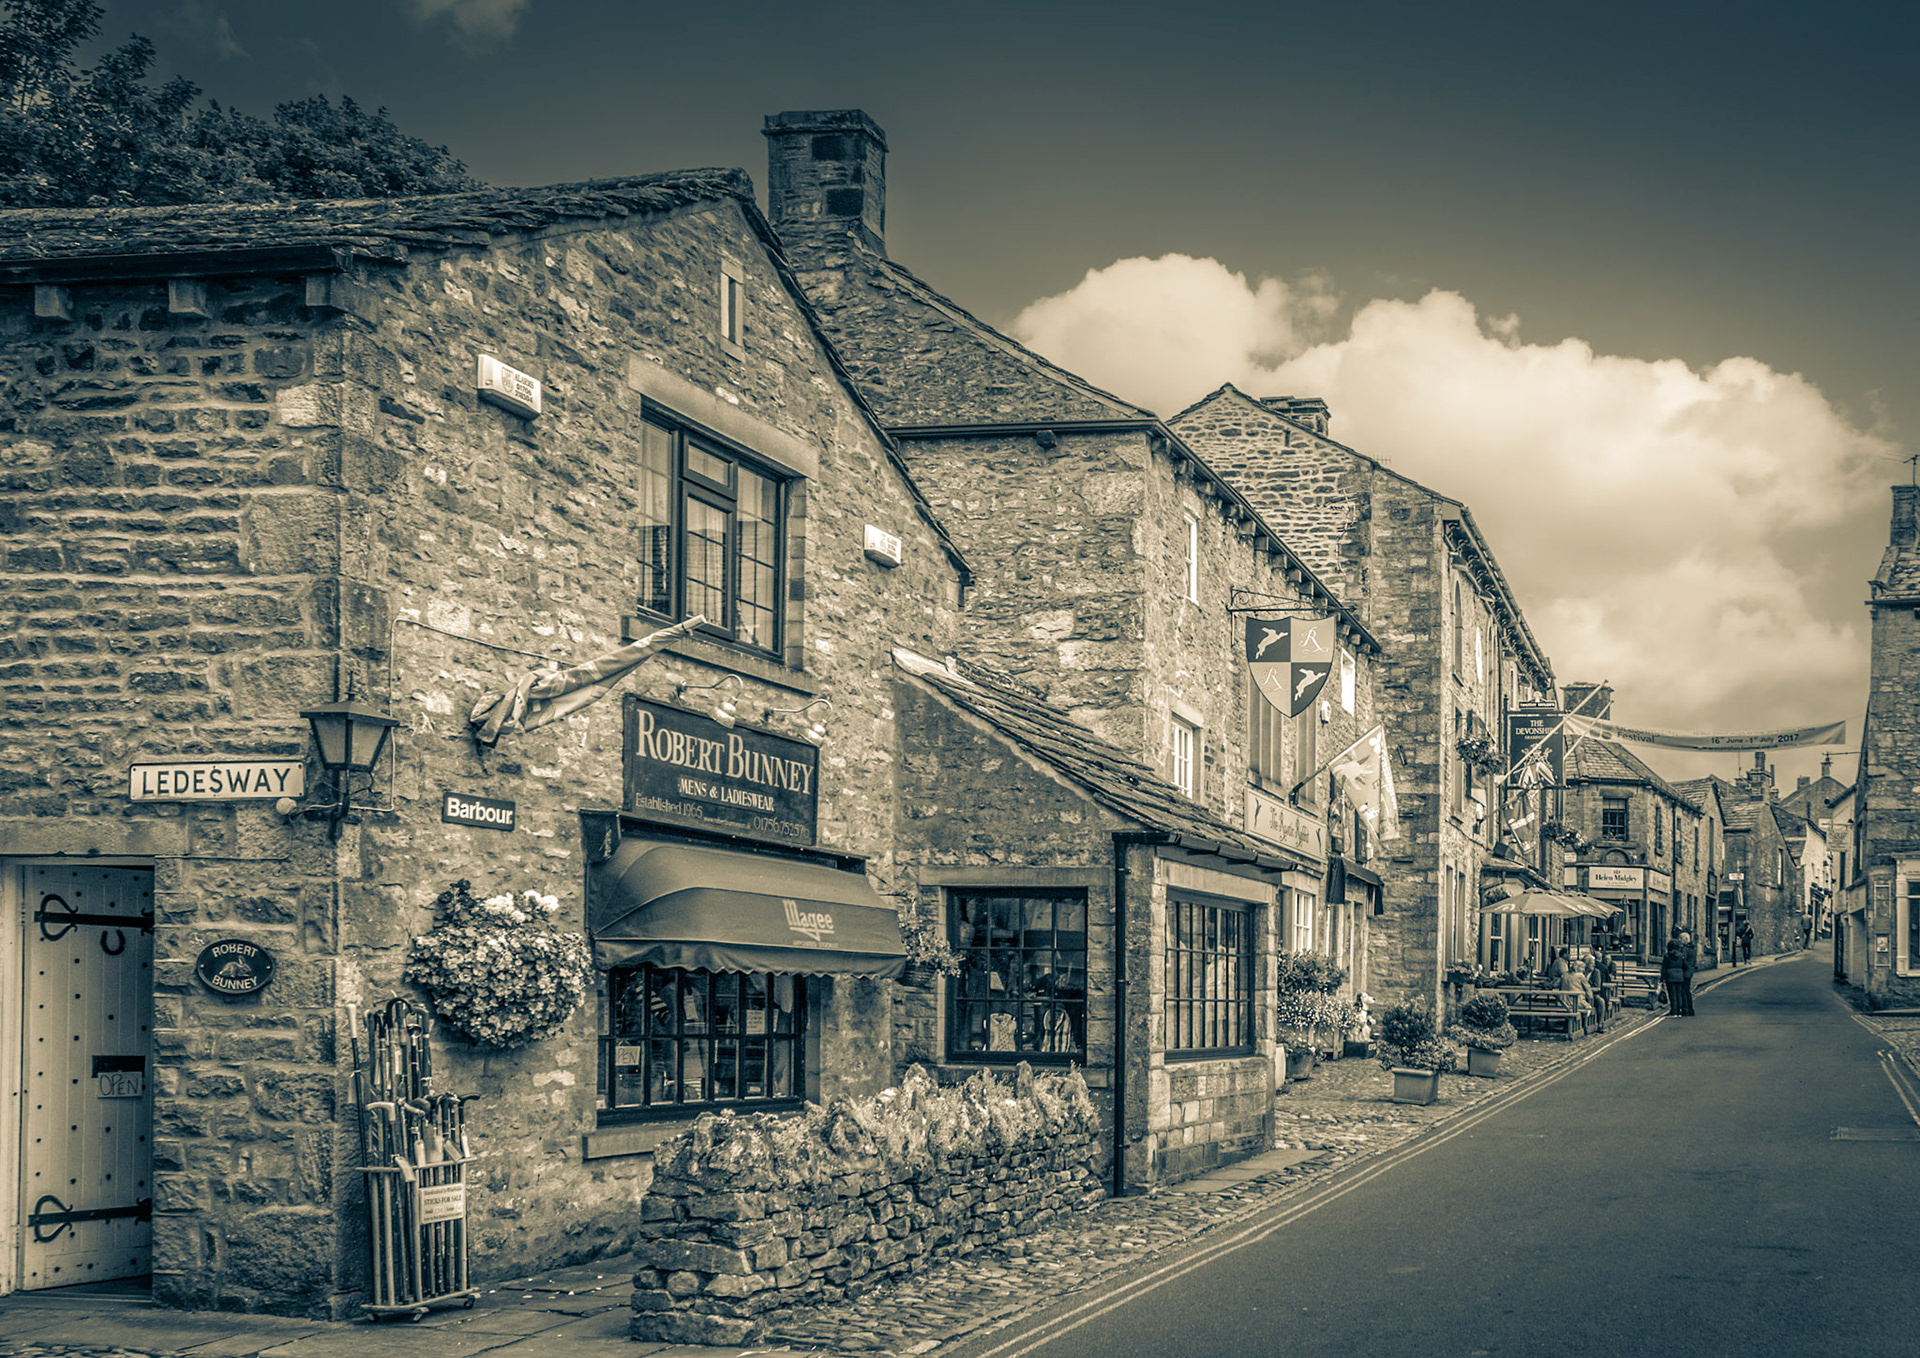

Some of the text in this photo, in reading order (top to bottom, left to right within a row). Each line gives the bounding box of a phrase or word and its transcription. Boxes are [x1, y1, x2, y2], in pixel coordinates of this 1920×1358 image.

[1299, 626, 1329, 654] R
[1617, 731, 1655, 743] Festival
[1777, 734, 1799, 742] 2017
[636, 709, 814, 794] ROBERT BUNNEY
[142, 768, 291, 795] LEDESWAY
[680, 778, 775, 811] MENS & LADIESWEAR
[635, 792, 703, 818] Established 1965
[753, 815, 779, 832] 01756
[1595, 873, 1637, 884] Helen Midgley
[782, 899, 834, 936] Magee
[211, 943, 258, 958] ROBERT
[212, 974, 258, 990] BUNNEY
[617, 1047, 638, 1065] PEN
[100, 1073, 139, 1096] OPEN
